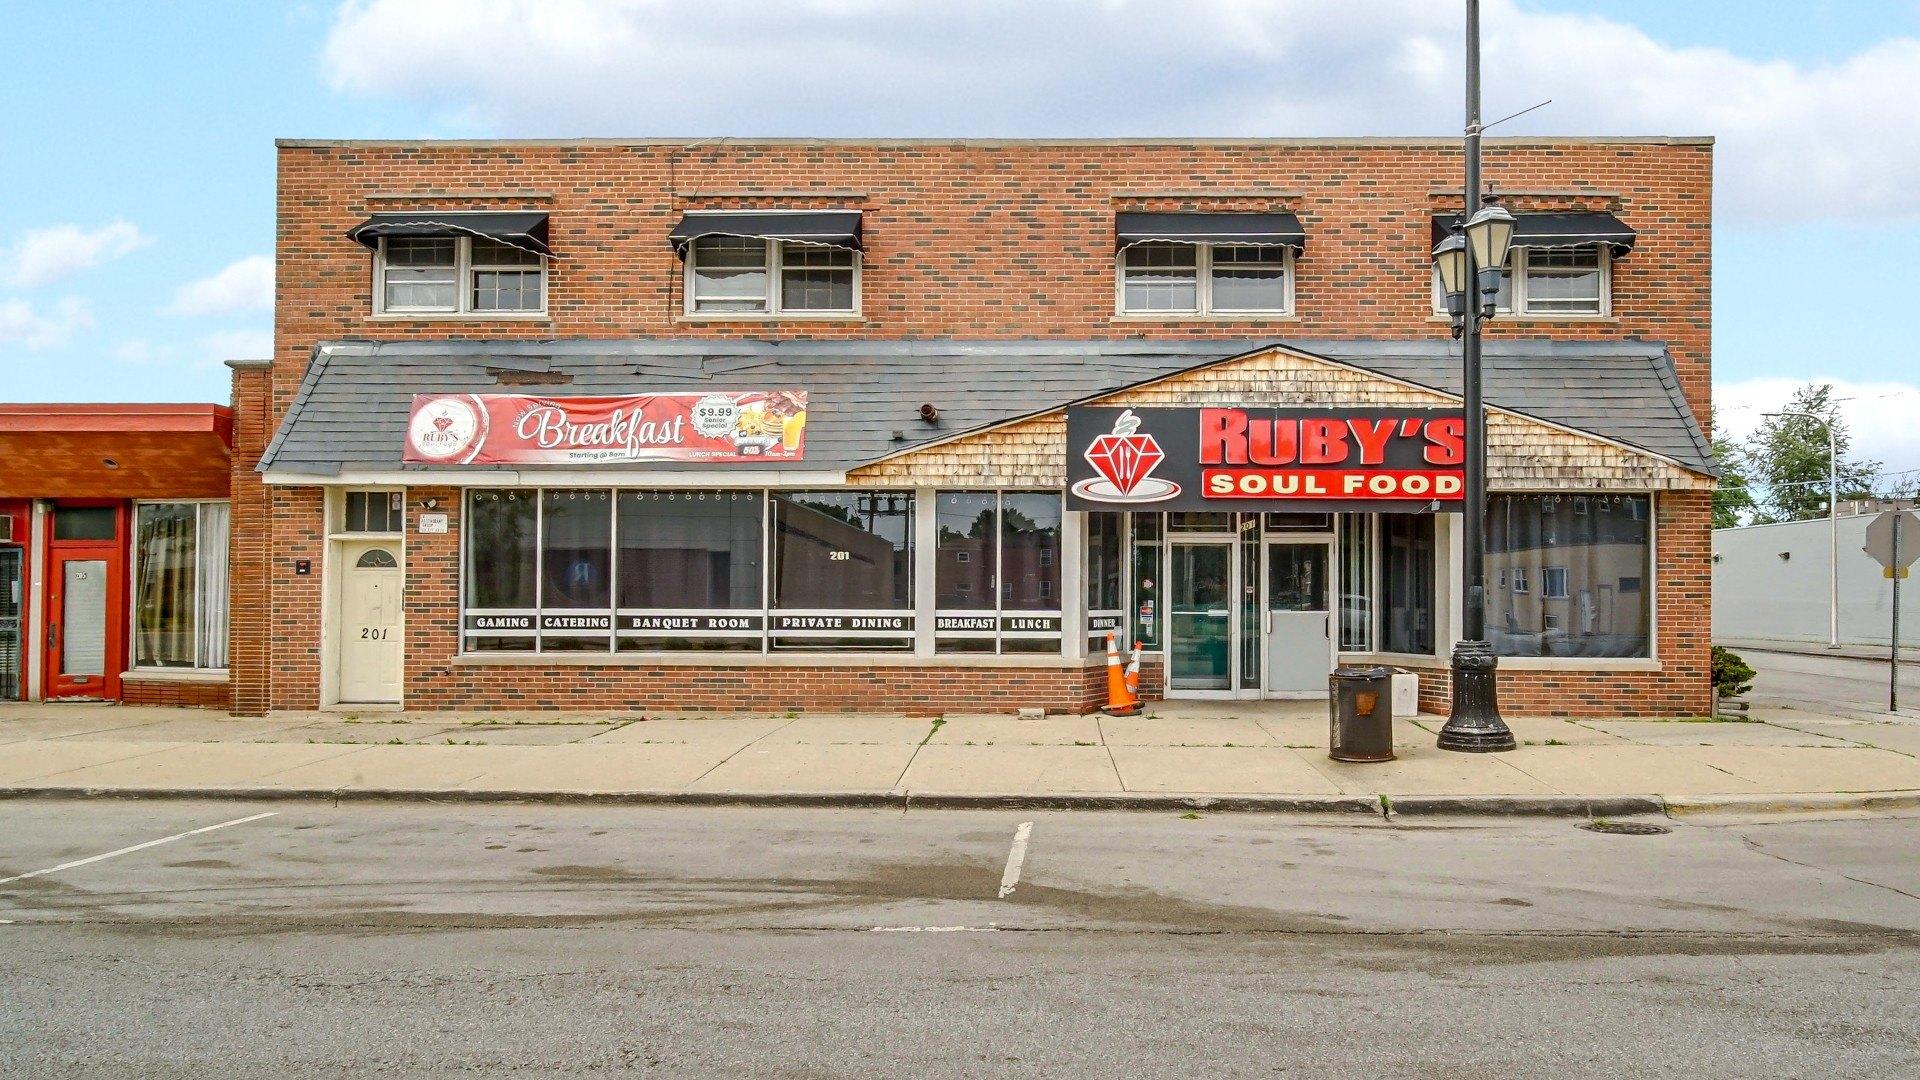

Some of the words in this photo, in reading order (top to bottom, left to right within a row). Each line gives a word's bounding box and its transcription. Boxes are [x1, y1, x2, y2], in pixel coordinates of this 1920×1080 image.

[699, 407, 732, 417] $9.99
[517, 406, 685, 459] Breakfast
[1199, 408, 1464, 465] RUBY'S
[1210, 474, 1327, 494] SOUL
[1343, 474, 1462, 494] FOOD
[830, 551, 850, 561] 201
[476, 617, 530, 628] GAMING
[544, 617, 609, 628] CATERING
[632, 617, 699, 629] BANQUET
[708, 617, 750, 628] ROOM
[782, 617, 842, 628] PRIVATE
[851, 617, 902, 628] DINING
[937, 617, 996, 629] BREAKFAST
[1011, 618, 1051, 629] LUNCH
[1093, 618, 1116, 628] DINNER
[360, 627, 388, 641] 201
